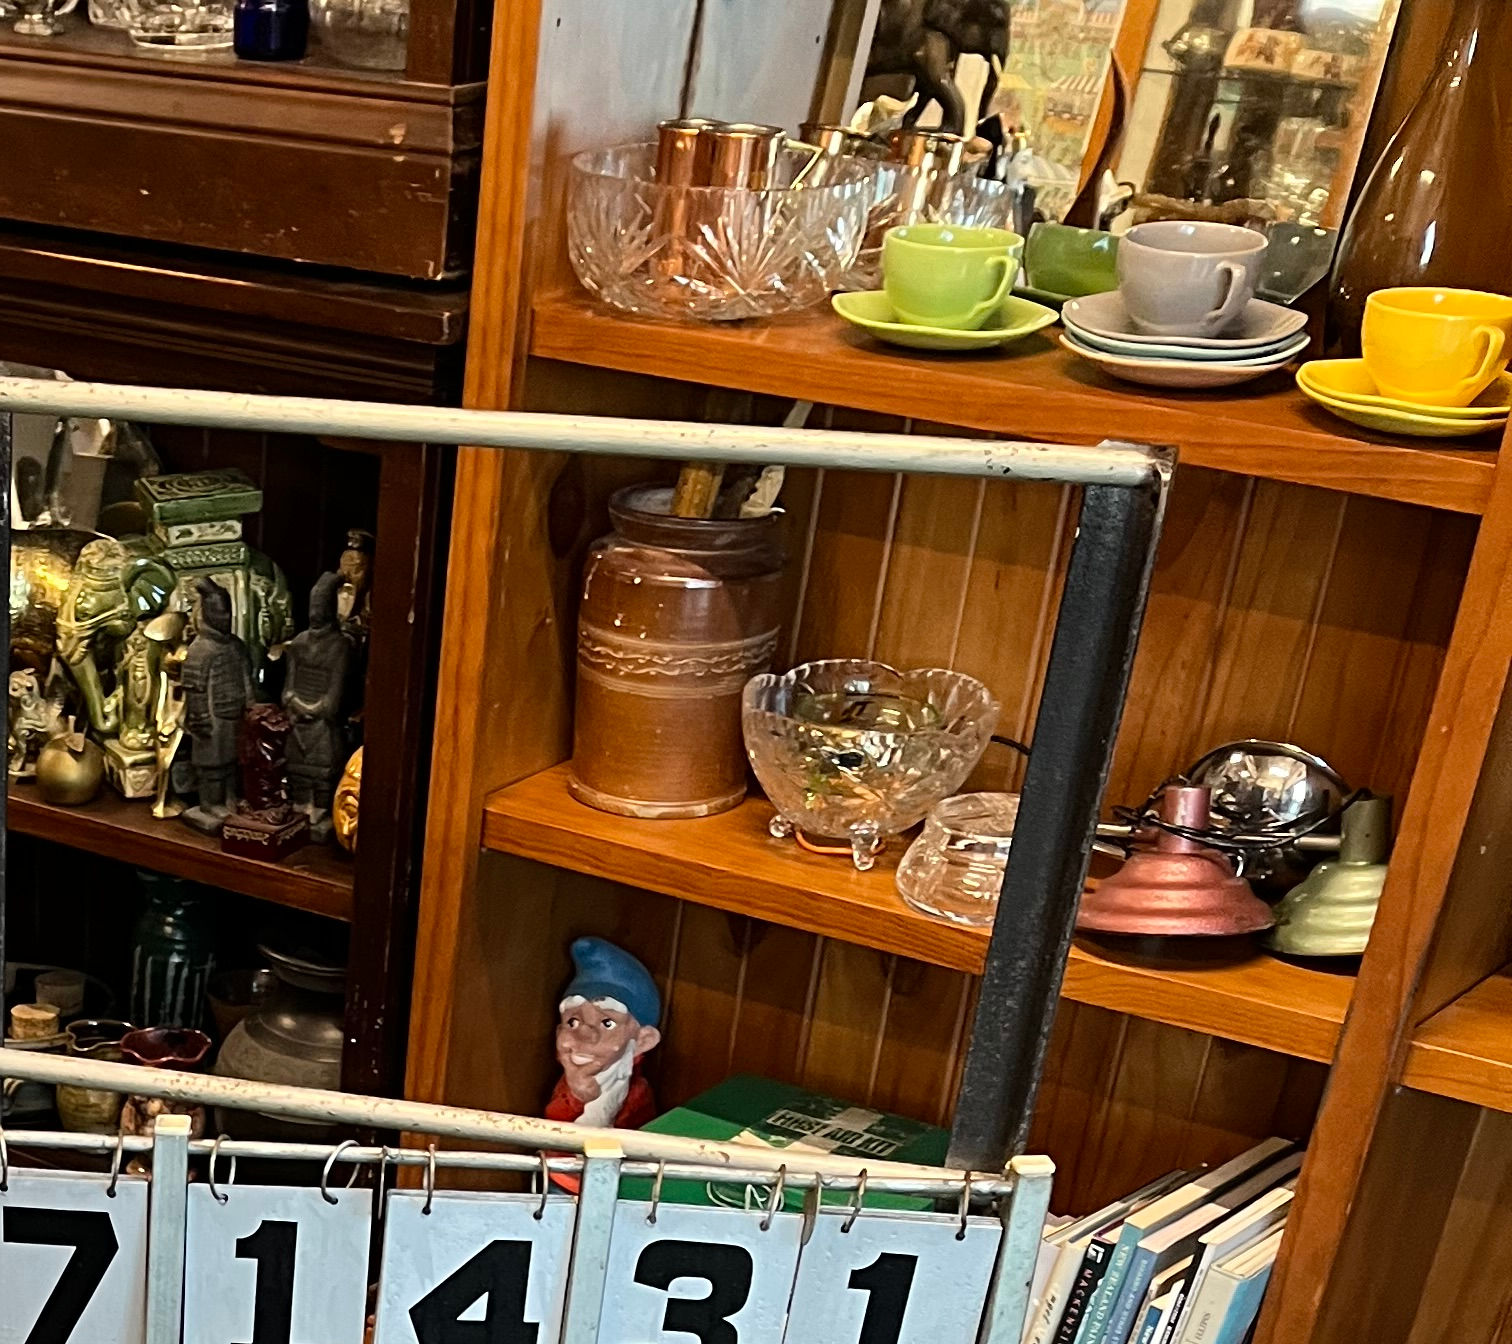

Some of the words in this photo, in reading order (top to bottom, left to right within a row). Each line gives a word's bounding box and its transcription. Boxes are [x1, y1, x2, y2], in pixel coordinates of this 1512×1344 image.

[821, 1127, 865, 1145] AID
[858, 1136, 897, 1154] KIT
[1115, 1244, 1129, 1269] NEW
[1095, 1270, 1120, 1321] ZEALAND
